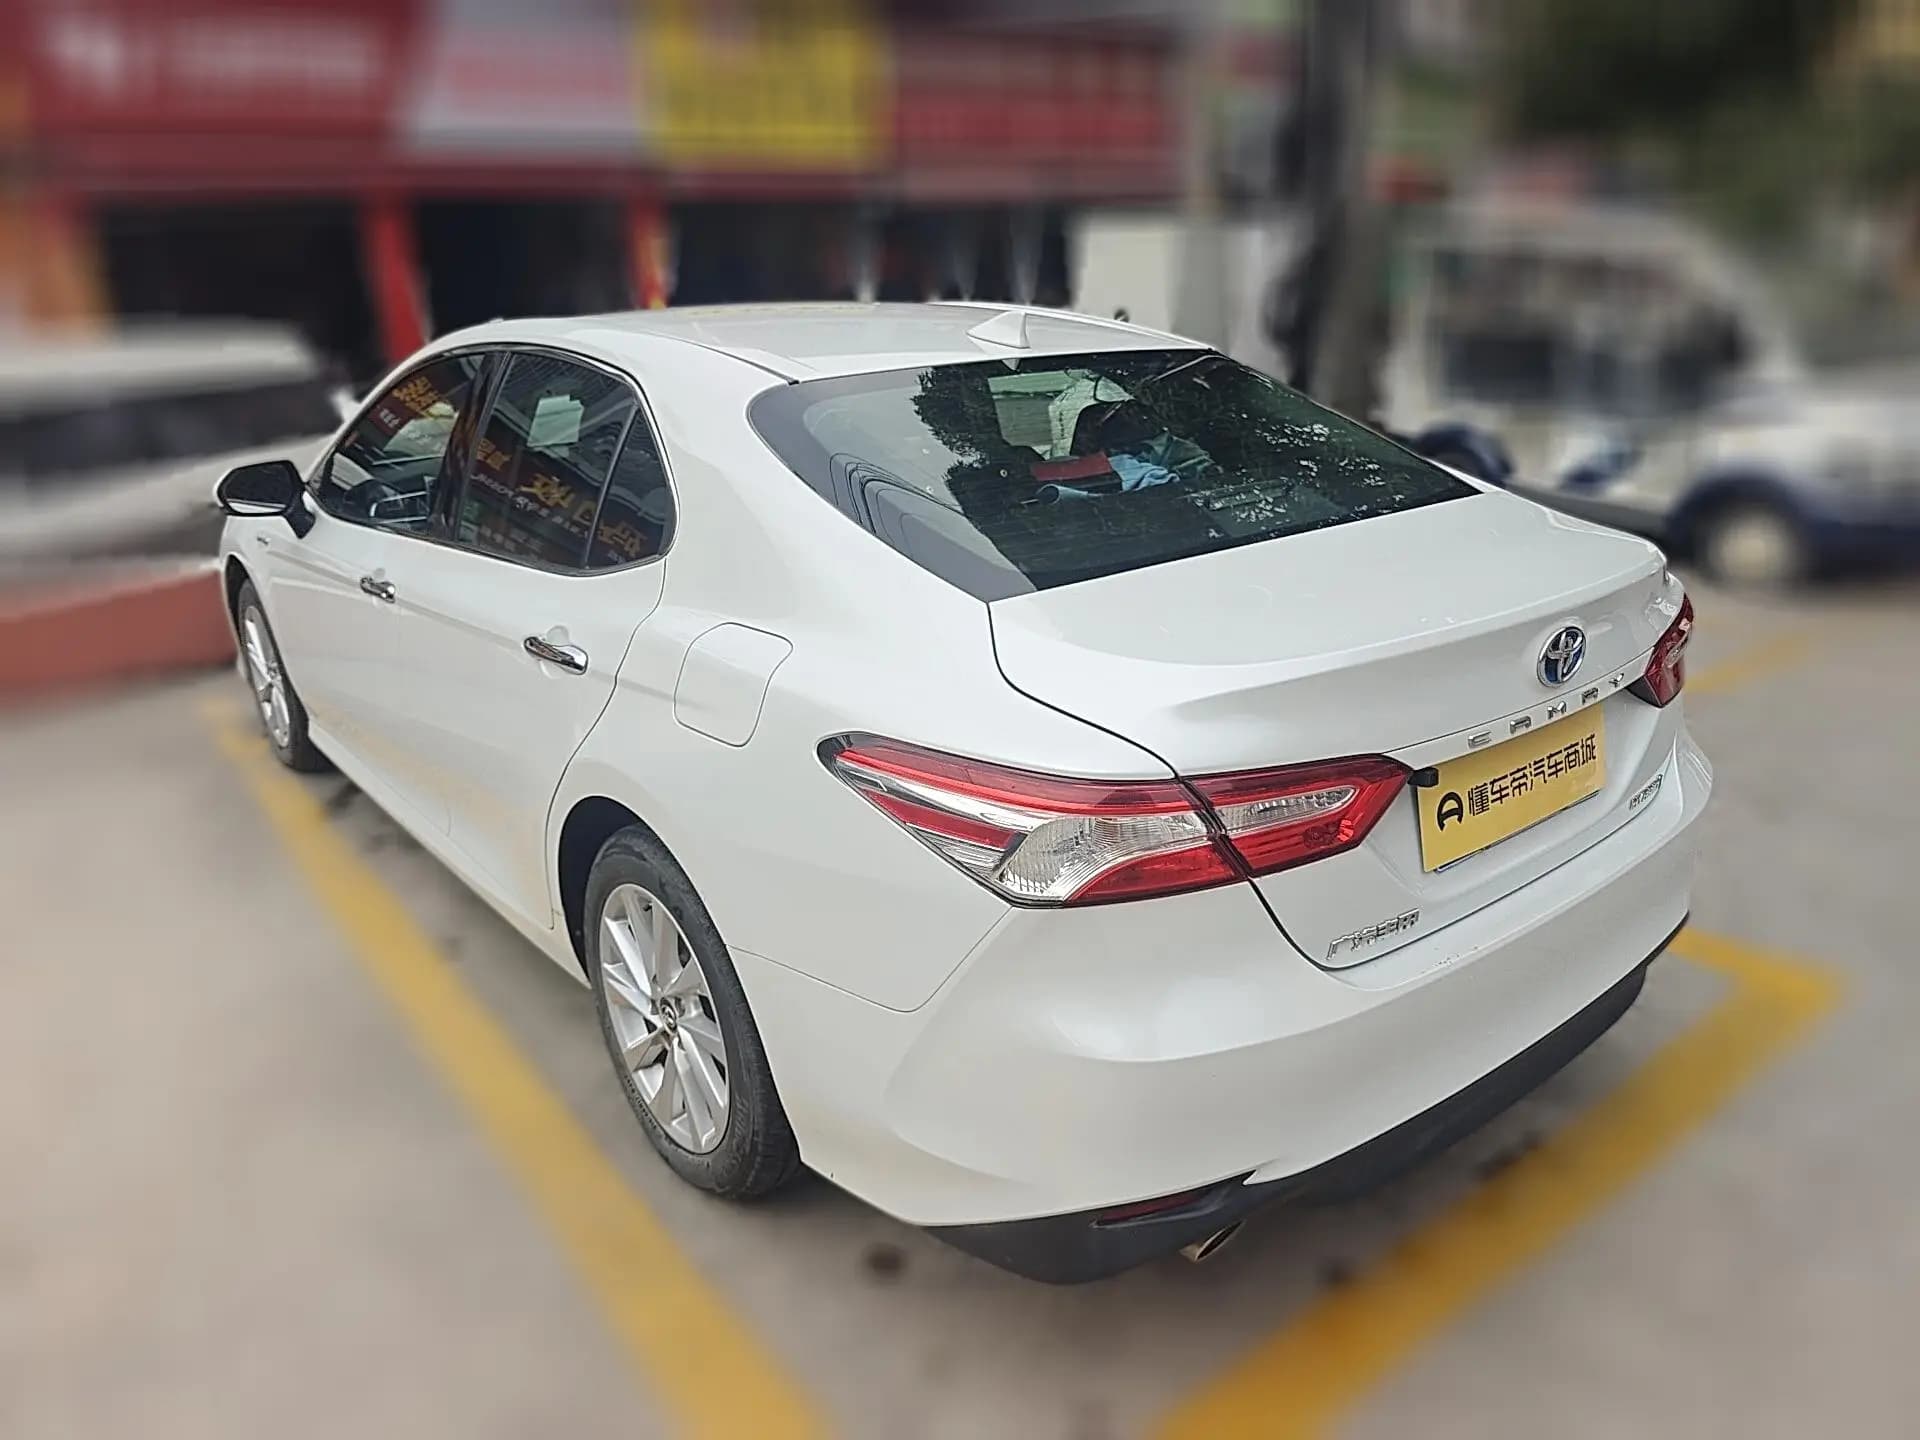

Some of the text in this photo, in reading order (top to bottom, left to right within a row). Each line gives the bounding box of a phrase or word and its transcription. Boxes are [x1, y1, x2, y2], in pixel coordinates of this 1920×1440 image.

[1467, 672, 1625, 749] CAMRY
[1467, 733, 1597, 816] 懂车帝汽车商城
